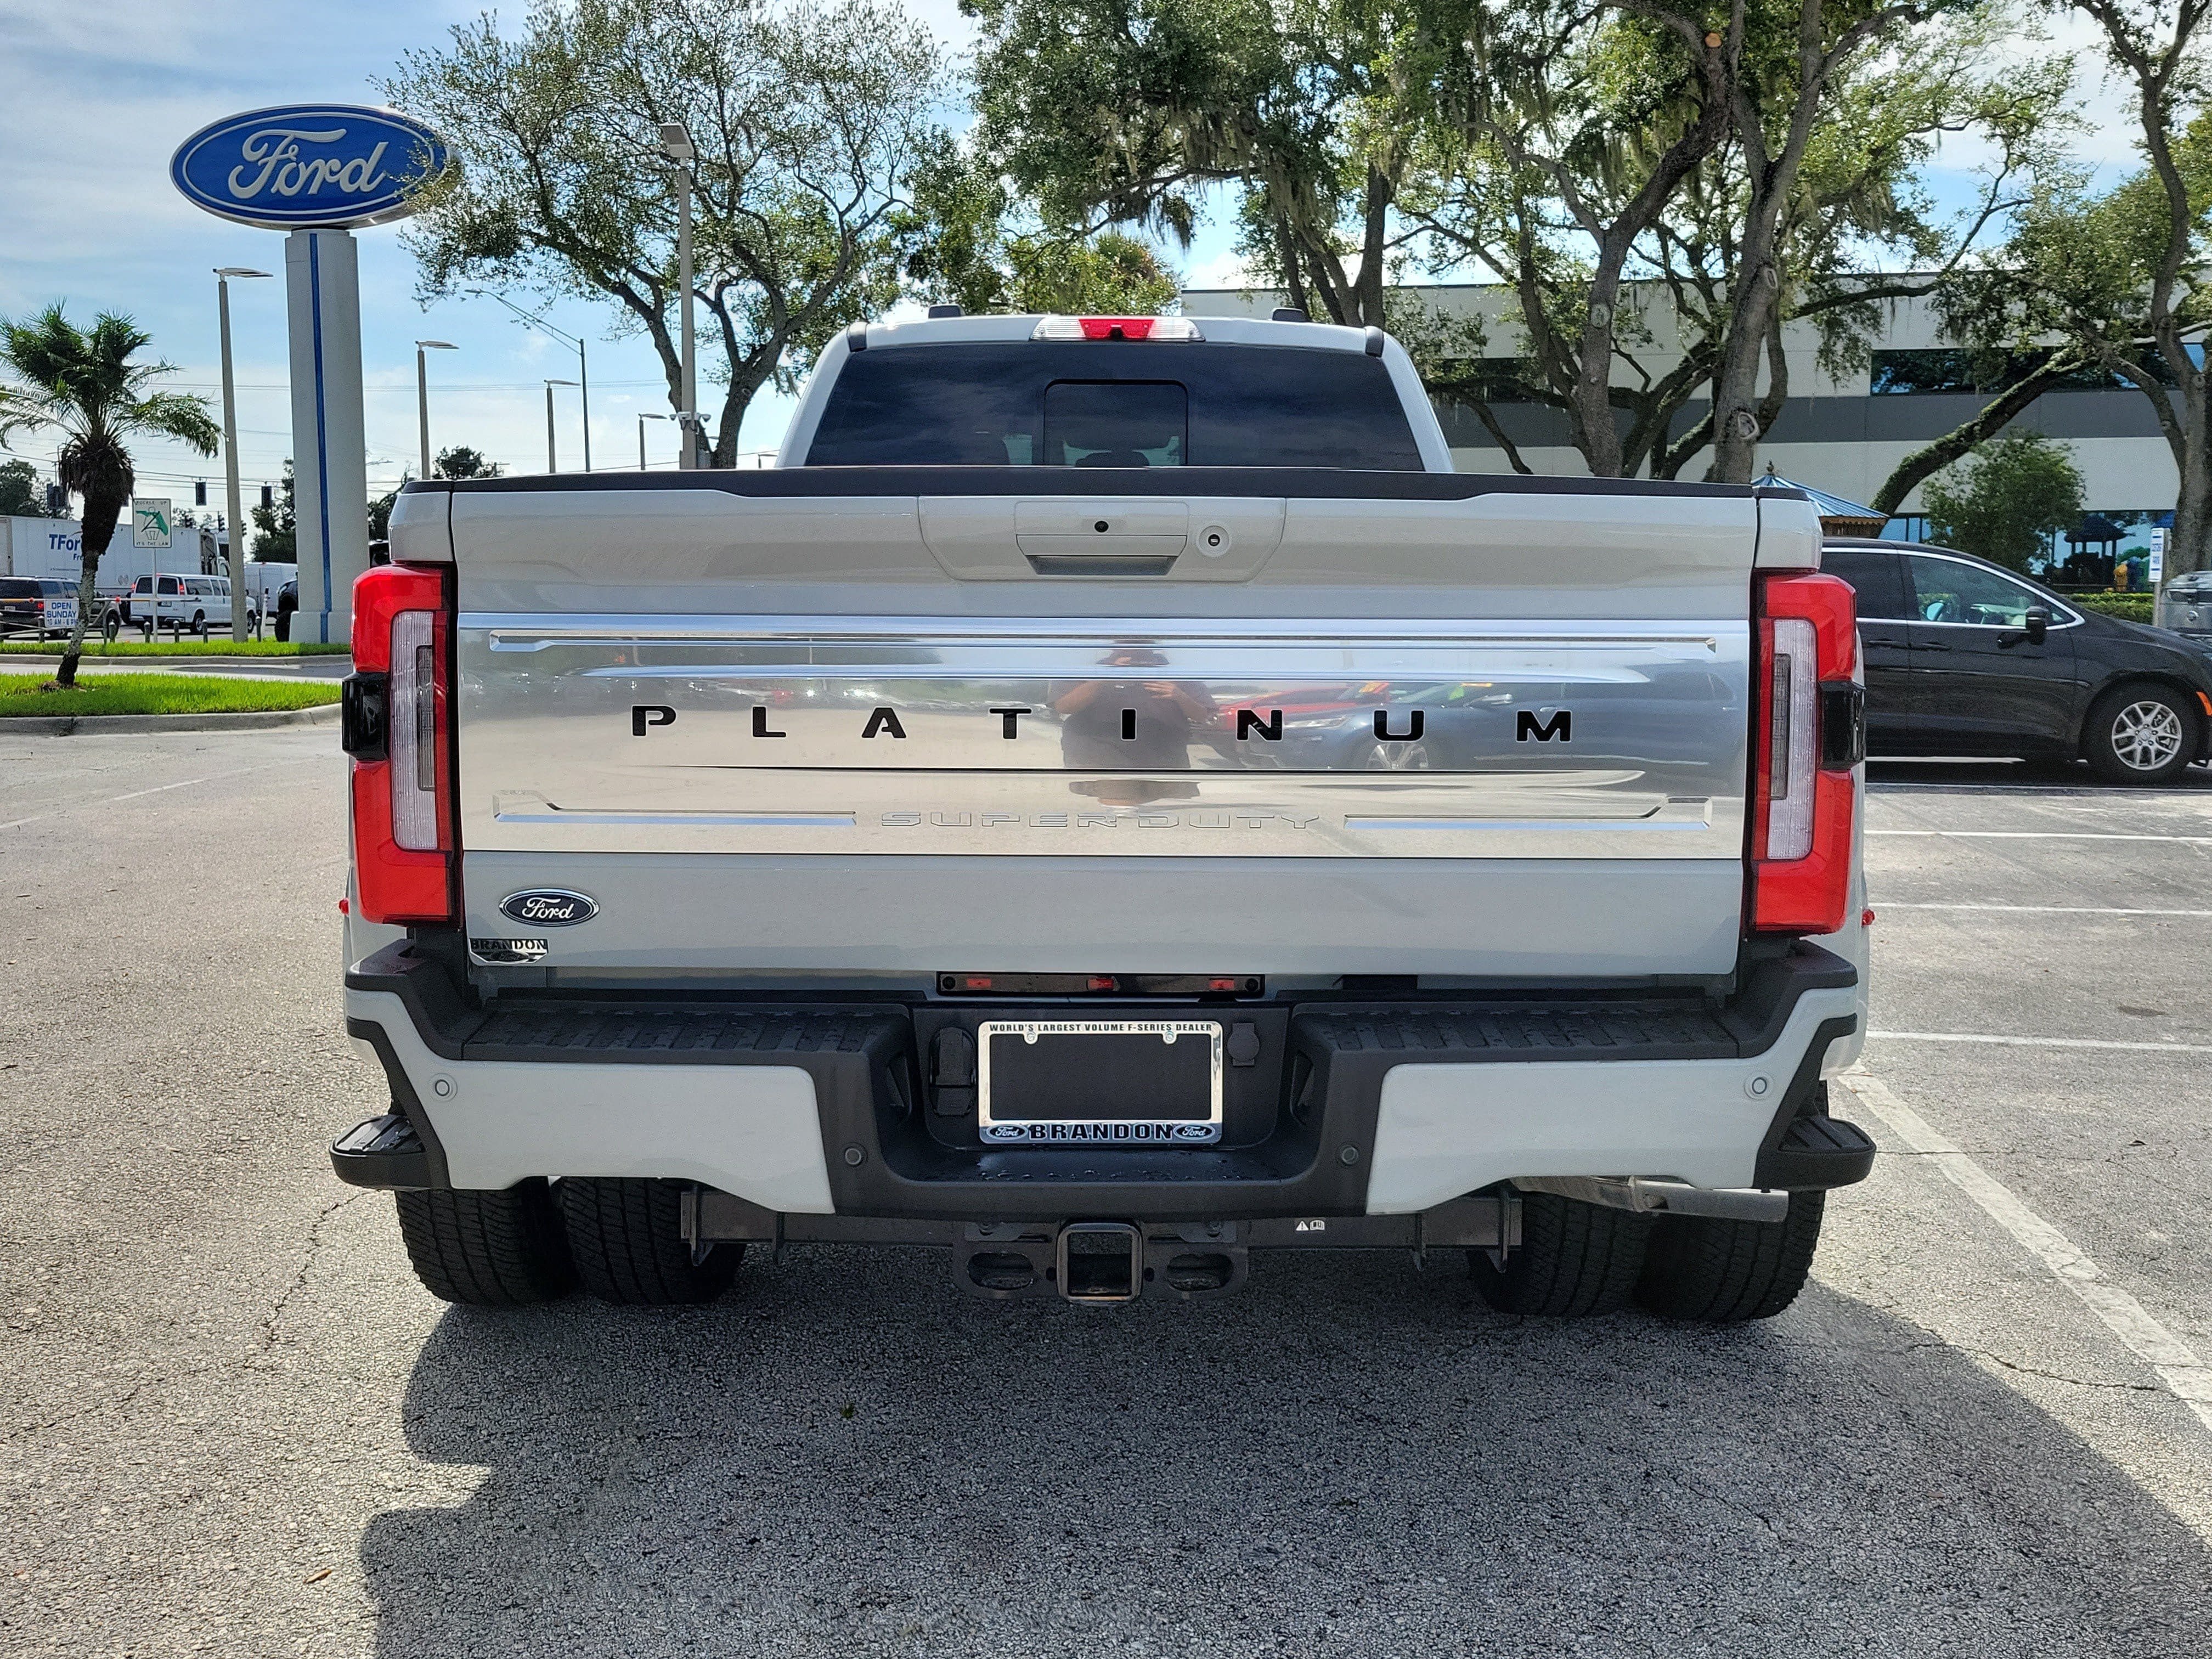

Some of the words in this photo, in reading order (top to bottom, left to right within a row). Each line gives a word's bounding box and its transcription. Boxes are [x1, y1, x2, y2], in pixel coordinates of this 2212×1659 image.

[228, 128, 389, 199] Ford
[49, 534, 81, 551] TFor
[631, 704, 1572, 743] PLATINUM
[521, 896, 574, 919] Ford
[470, 939, 546, 950] BRANDON
[989, 1024, 1034, 1032] WORLD'S
[1037, 1024, 1081, 1032] LARGEST
[1175, 1023, 1212, 1031] DEALER
[995, 1126, 1019, 1138] Ford
[1028, 1123, 1173, 1140] BRANDON
[1181, 1125, 1206, 1137] Ford
